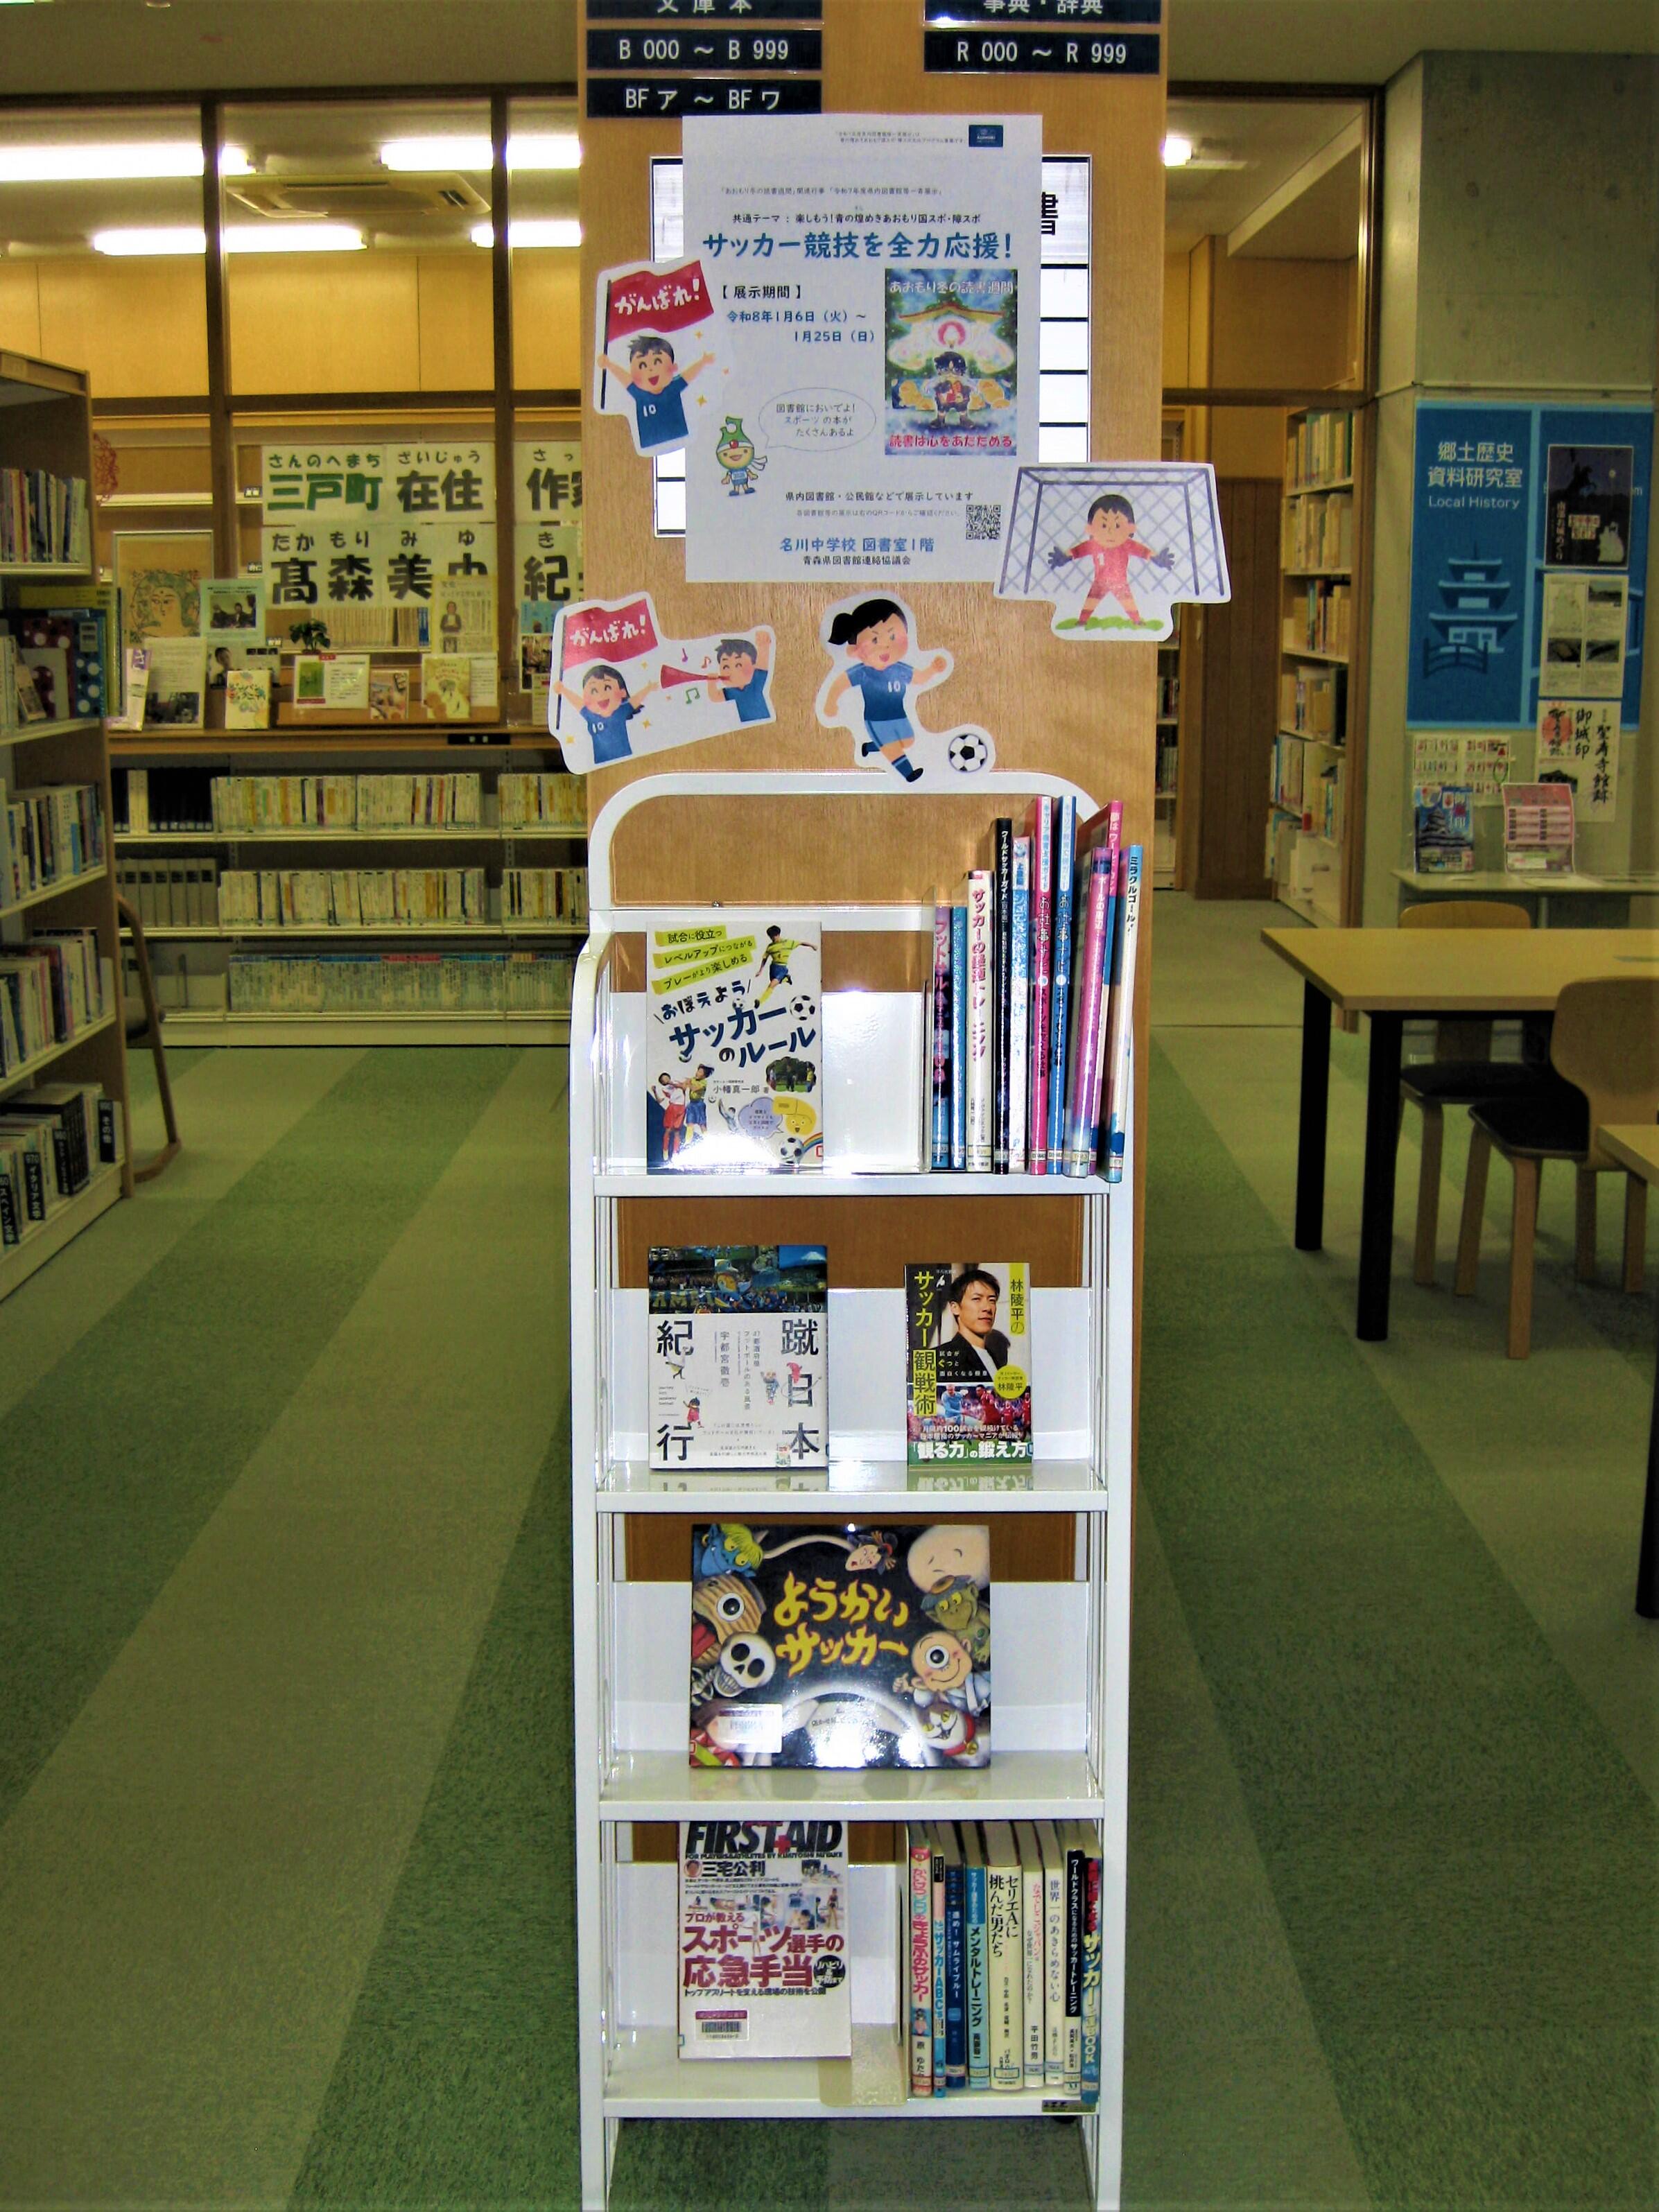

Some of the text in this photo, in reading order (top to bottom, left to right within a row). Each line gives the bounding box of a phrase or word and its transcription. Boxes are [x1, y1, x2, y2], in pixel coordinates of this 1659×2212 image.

[619, 40, 630, 60] B
[643, 40, 679, 60] 000
[729, 40, 740, 60] B
[753, 40, 788, 60] 999
[957, 41, 969, 62] R
[982, 42, 1018, 62] 000
[1066, 42, 1078, 63] R
[1091, 43, 1127, 63] 999
[625, 88, 649, 109] BF
[658, 90, 677, 110] ア
[729, 89, 752, 110] BF
[762, 92, 779, 110] ワ
[796, 428, 854, 437] たくさんあるよ
[889, 435, 1011, 447] 読書は心をあたためる
[1438, 441, 1514, 462] 郷土歴史
[267, 473, 383, 512] 三戸町
[396, 469, 483, 512] 在住
[1427, 467, 1522, 489] 資料研究室
[1428, 495, 1520, 510] Local History
[779, 537, 857, 552] 名川中学校
[663, 940, 754, 964] レベルアップにつながる
[668, 930, 722, 943] 試合に役立つ
[663, 954, 748, 990] プレーがより楽しめる
[661, 980, 746, 1021] おぼえよう
[669, 1007, 787, 1058] サッカー
[719, 1027, 816, 1068] のルール
[1010, 1279, 1025, 1334] 林陵平の
[914, 1271, 936, 1415] サッカー観戦術
[657, 1320, 694, 1461] 紀行
[774, 1571, 909, 1627] ようかい
[776, 1622, 909, 1677] サッカー
[702, 1859, 766, 1877] 三宅公利
[686, 1912, 745, 1924] プロが教える
[989, 1874, 1004, 1958] 挑んだ男たち
[1006, 1875, 1019, 1938] セリエAに
[1050, 1879, 1061, 2003] 世界一のあきらめない心
[683, 1954, 813, 1988] 応急手当
[971, 1926, 982, 2027] メンタルトレーニング
[1031, 2026, 1039, 2060] 平田竹男
